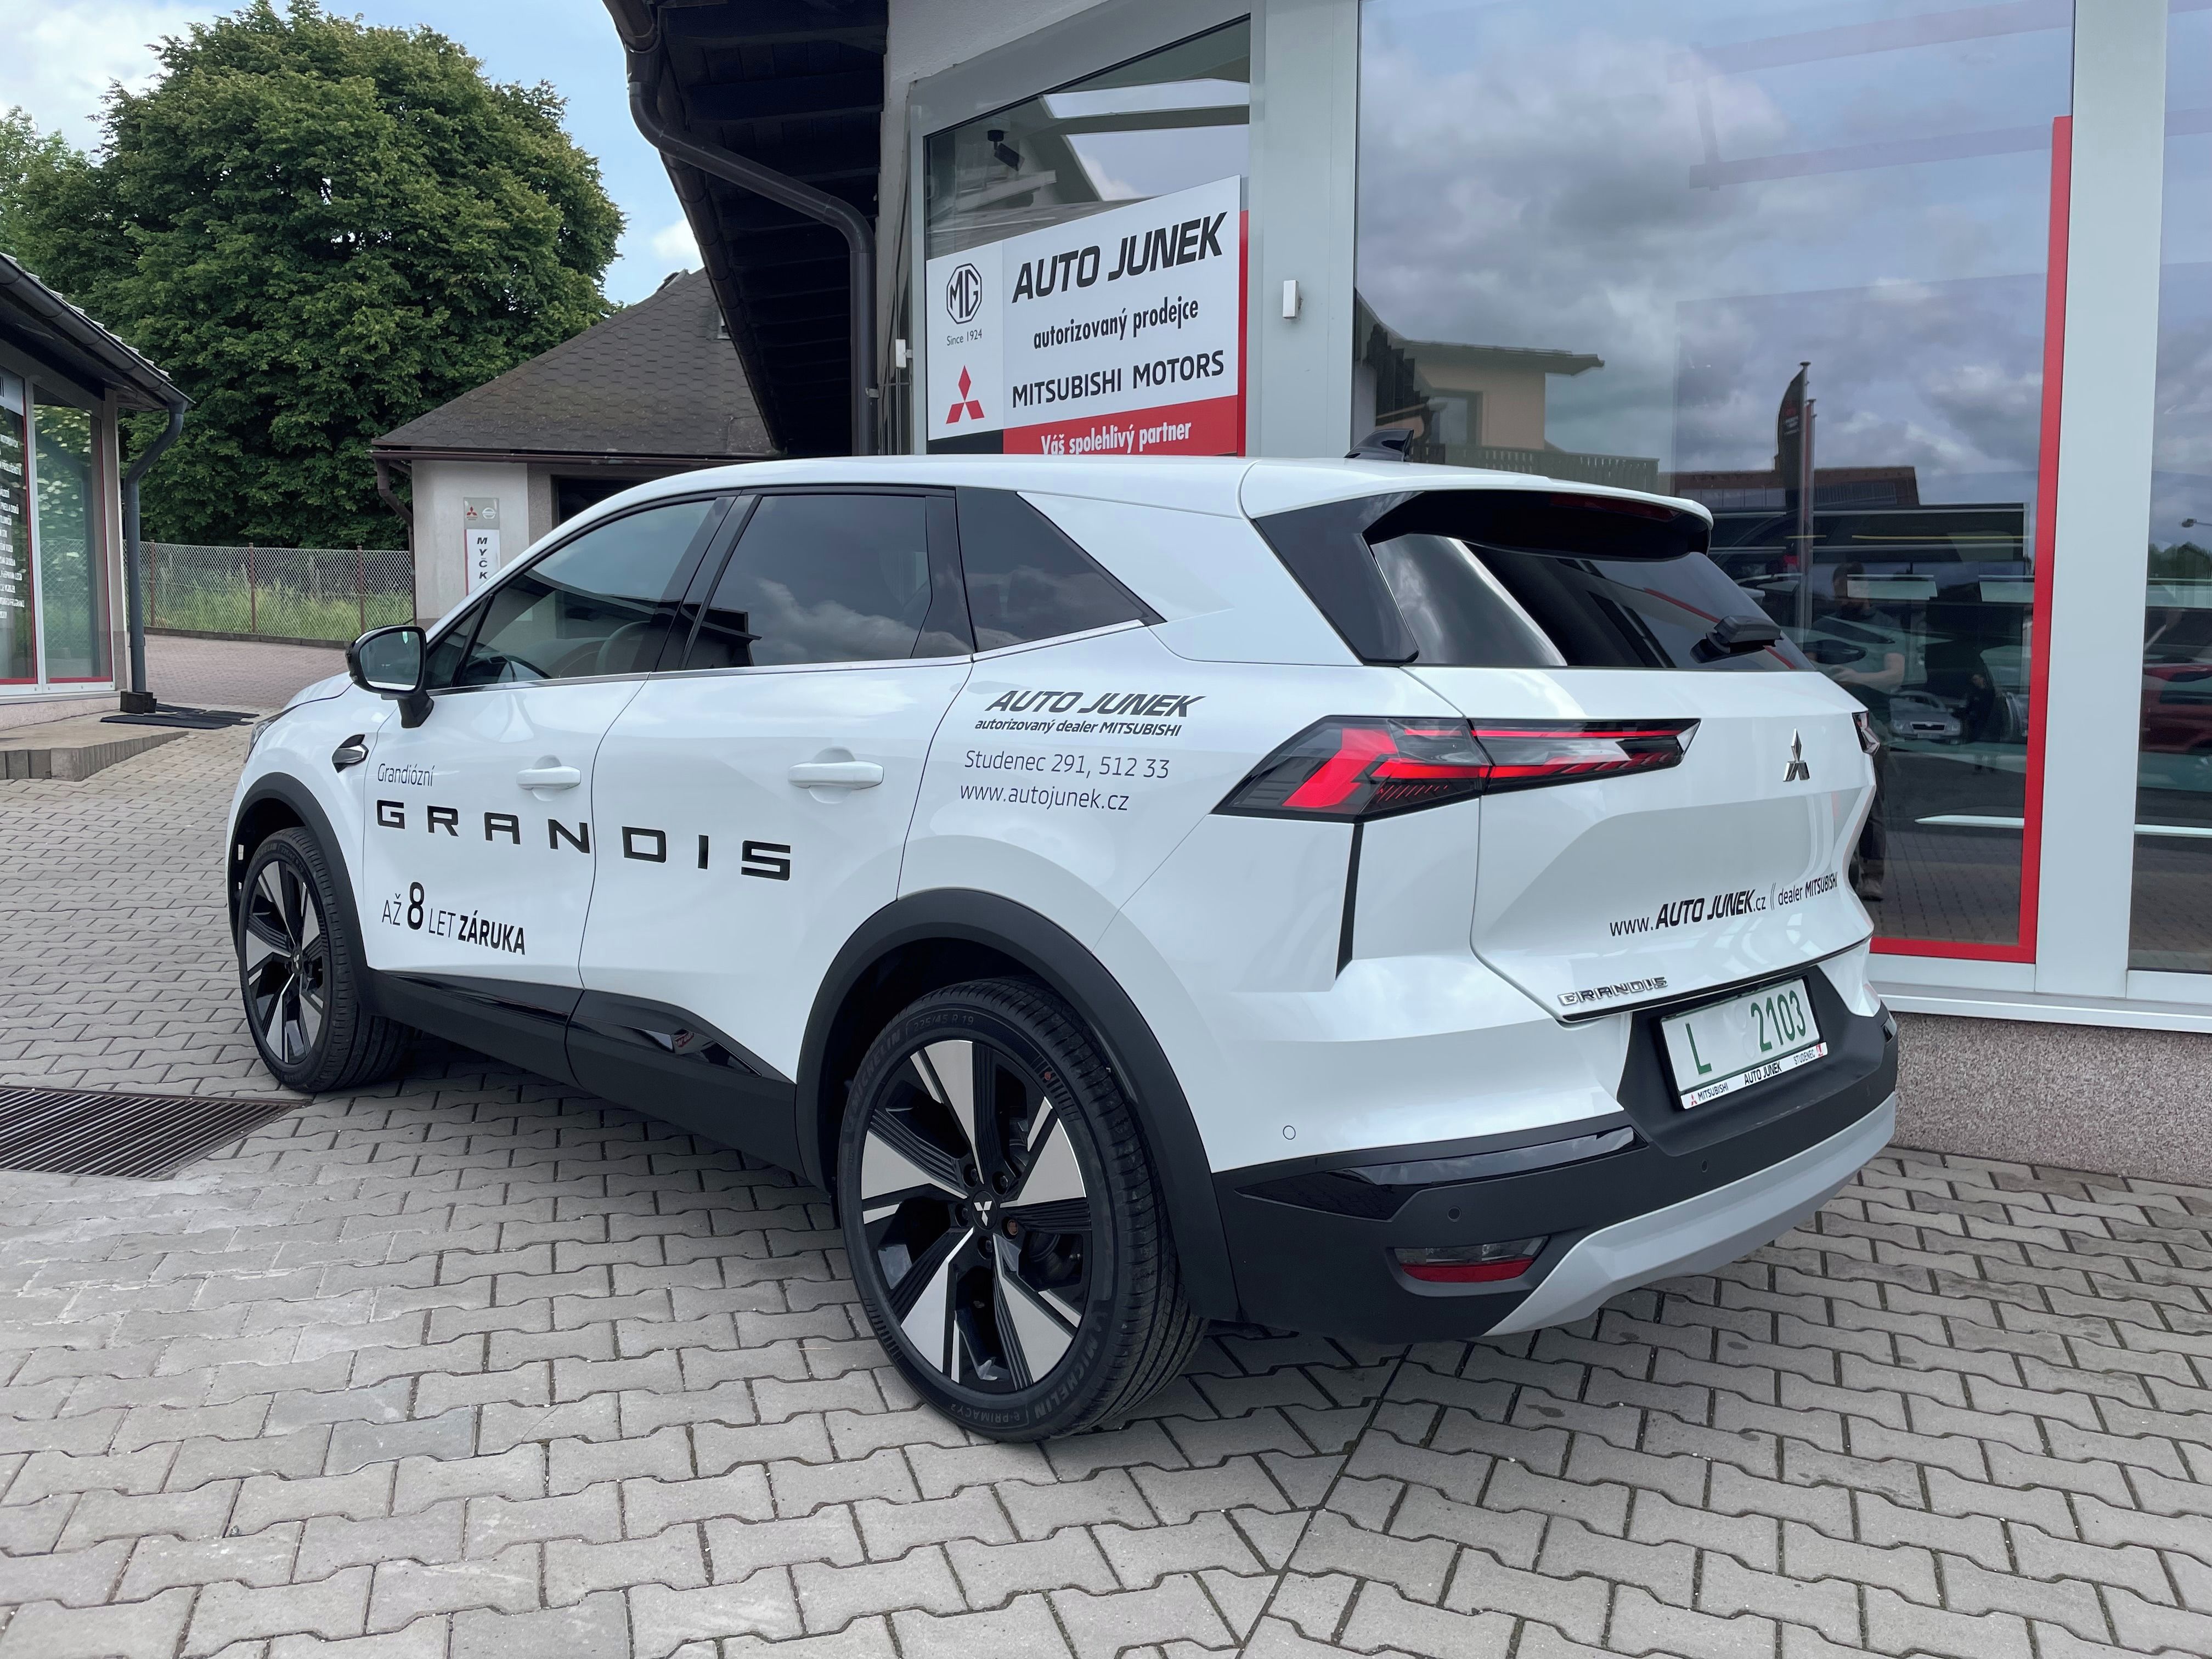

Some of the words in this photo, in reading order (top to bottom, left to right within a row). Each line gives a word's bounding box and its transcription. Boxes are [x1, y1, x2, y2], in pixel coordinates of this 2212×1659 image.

[1012, 245, 1100, 303] AUTO
[1107, 211, 1228, 282] JUNEK
[949, 268, 979, 319] MG
[946, 335, 964, 346] Since
[967, 328, 983, 342] 1924
[1034, 308, 1128, 349] autorizovaný
[1133, 296, 1199, 338] prodejce
[1012, 368, 1122, 409] MITSUBISHI
[1133, 350, 1224, 389] MOTORS
[1040, 433, 1065, 455] Váš
[1069, 424, 1135, 455] spolehlivý
[1139, 422, 1192, 452] partner
[984, 690, 1084, 713] AUTO
[1076, 692, 1207, 718] JUNEK
[974, 718, 1056, 735] autorizovaný
[1056, 719, 1099, 733] dealer
[1098, 721, 1182, 737] MITSUBISHI
[377, 763, 435, 787] Grandiózní
[964, 749, 1046, 772] Studenec
[1051, 753, 1092, 779] 291,
[1099, 756, 1137, 777] 512
[1143, 758, 1170, 779] 33
[960, 785, 1129, 811] www.autojunek.cz
[376, 799, 791, 881] GRANDIS
[1778, 885, 1803, 906] dealer
[1805, 871, 1838, 899] MITSUBISHI
[381, 893, 402, 926] AŽ
[407, 881, 425, 930] 8
[428, 908, 456, 938] LET
[458, 910, 526, 956] ZÁRUKA
[1557, 976, 1669, 1007] GRANDIS
[1685, 1023, 1712, 1076] L
[1750, 990, 1807, 1053] 2103
[1697, 1082, 1729, 1102] MITSUBISHI
[1744, 1071, 1762, 1086] AUTO
[1763, 1061, 1782, 1079] JUNEK
[1793, 1049, 1816, 1065] STUDENEC
